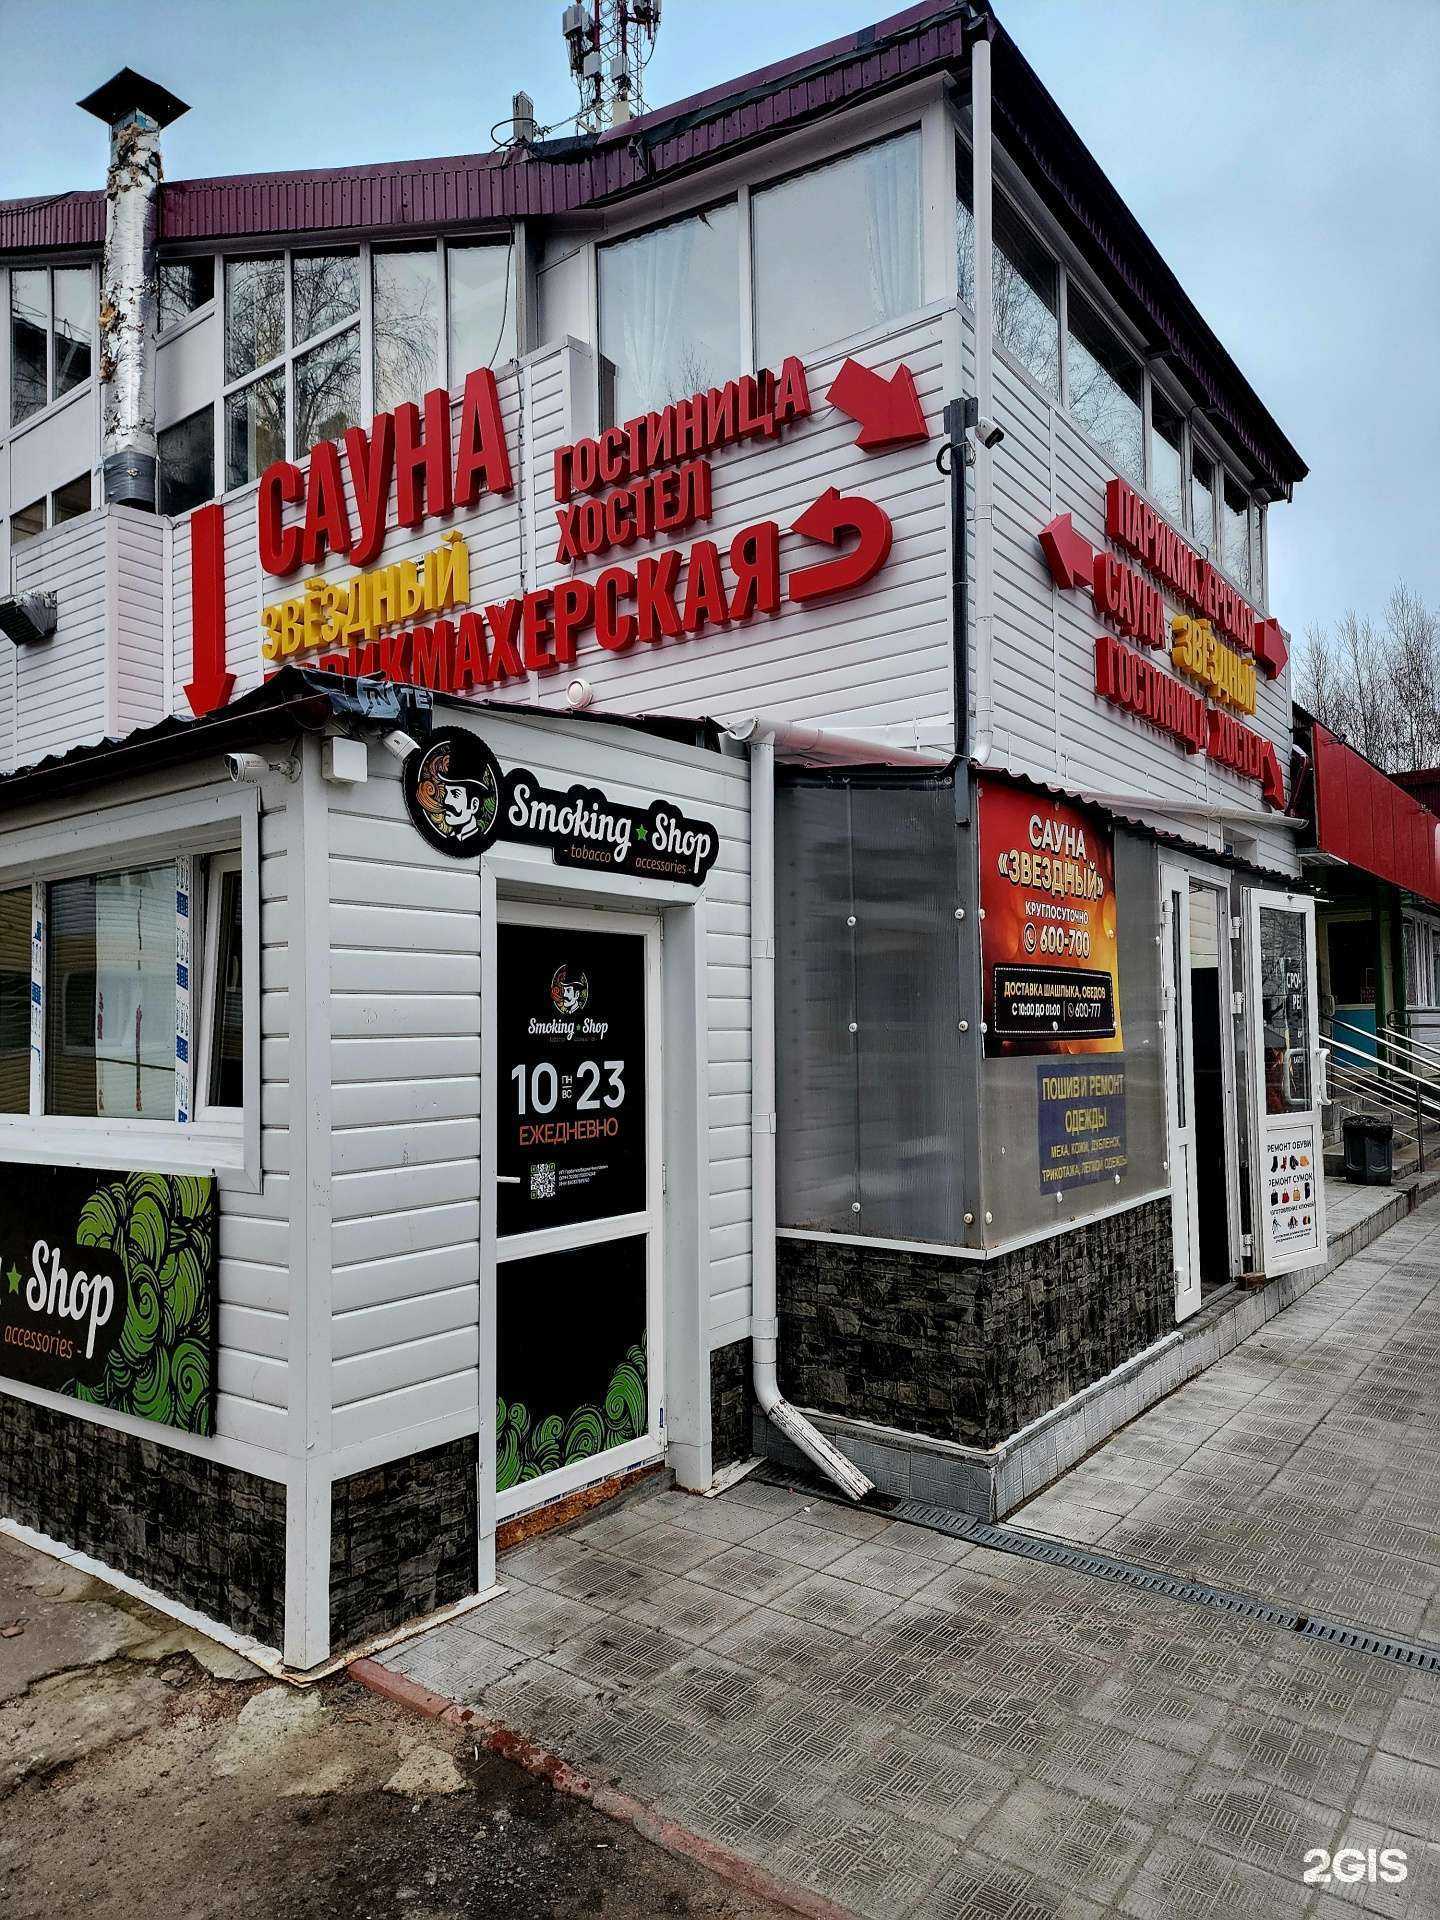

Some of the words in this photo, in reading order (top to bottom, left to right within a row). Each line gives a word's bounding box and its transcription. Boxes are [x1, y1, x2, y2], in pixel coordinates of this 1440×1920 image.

[553, 355, 812, 502] ГОСТИНИЦА
[258, 366, 513, 578] САУНА
[555, 460, 713, 565] ХОСТЕЛ
[1106, 478, 1258, 655] ПАРИКМАХЕРСКАЯ
[260, 530, 471, 661] ЗВЁЗДНЫЙ
[1093, 552, 1166, 651] САУНА
[1095, 636, 1208, 755] ГОСТИНИЦА
[508, 783, 631, 862] Smoking
[651, 812, 711, 873] Shop
[1029, 814, 1087, 860] САУНА
[571, 843, 611, 863] tobacco
[635, 855, 687, 875] accessories
[998, 849, 1104, 901] «ЗВЕЗДНЫЙ»
[1025, 900, 1089, 925] КРУГЛОСУТОЧНО
[1039, 924, 1091, 958] 600-700
[1004, 981, 1043, 998] ДОСТАВКА
[1043, 983, 1081, 999] ШАШЛЫКА,
[1082, 986, 1106, 1000] ОБЕДОВ
[1011, 1002, 1018, 1015] С
[1018, 1003, 1035, 1016] 10:00
[1035, 1003, 1045, 1018] ДО
[1074, 1003, 1101, 1018] 600-777
[528, 1017, 575, 1040] Smoking
[582, 1017, 609, 1040] Shop
[511, 1062, 558, 1115] 10
[576, 1060, 626, 1111] 23
[562, 1075, 573, 1085] ПН
[562, 1089, 572, 1099] ВС
[1089, 1073, 1124, 1097] РЕМОНТ
[519, 1118, 619, 1146] ЕЖЕДНЕВНО
[1065, 1107, 1107, 1136] ОДЕЖДЫ
[1267, 1142, 1291, 1153] РЕМОНТ
[1292, 1139, 1312, 1150] ОБУВИ
[1268, 1175, 1292, 1187] РЕМОНТ
[1292, 1172, 1313, 1183] СУМОК
[26, 1239, 115, 1359] Shop
[4, 1324, 74, 1360] accessories
